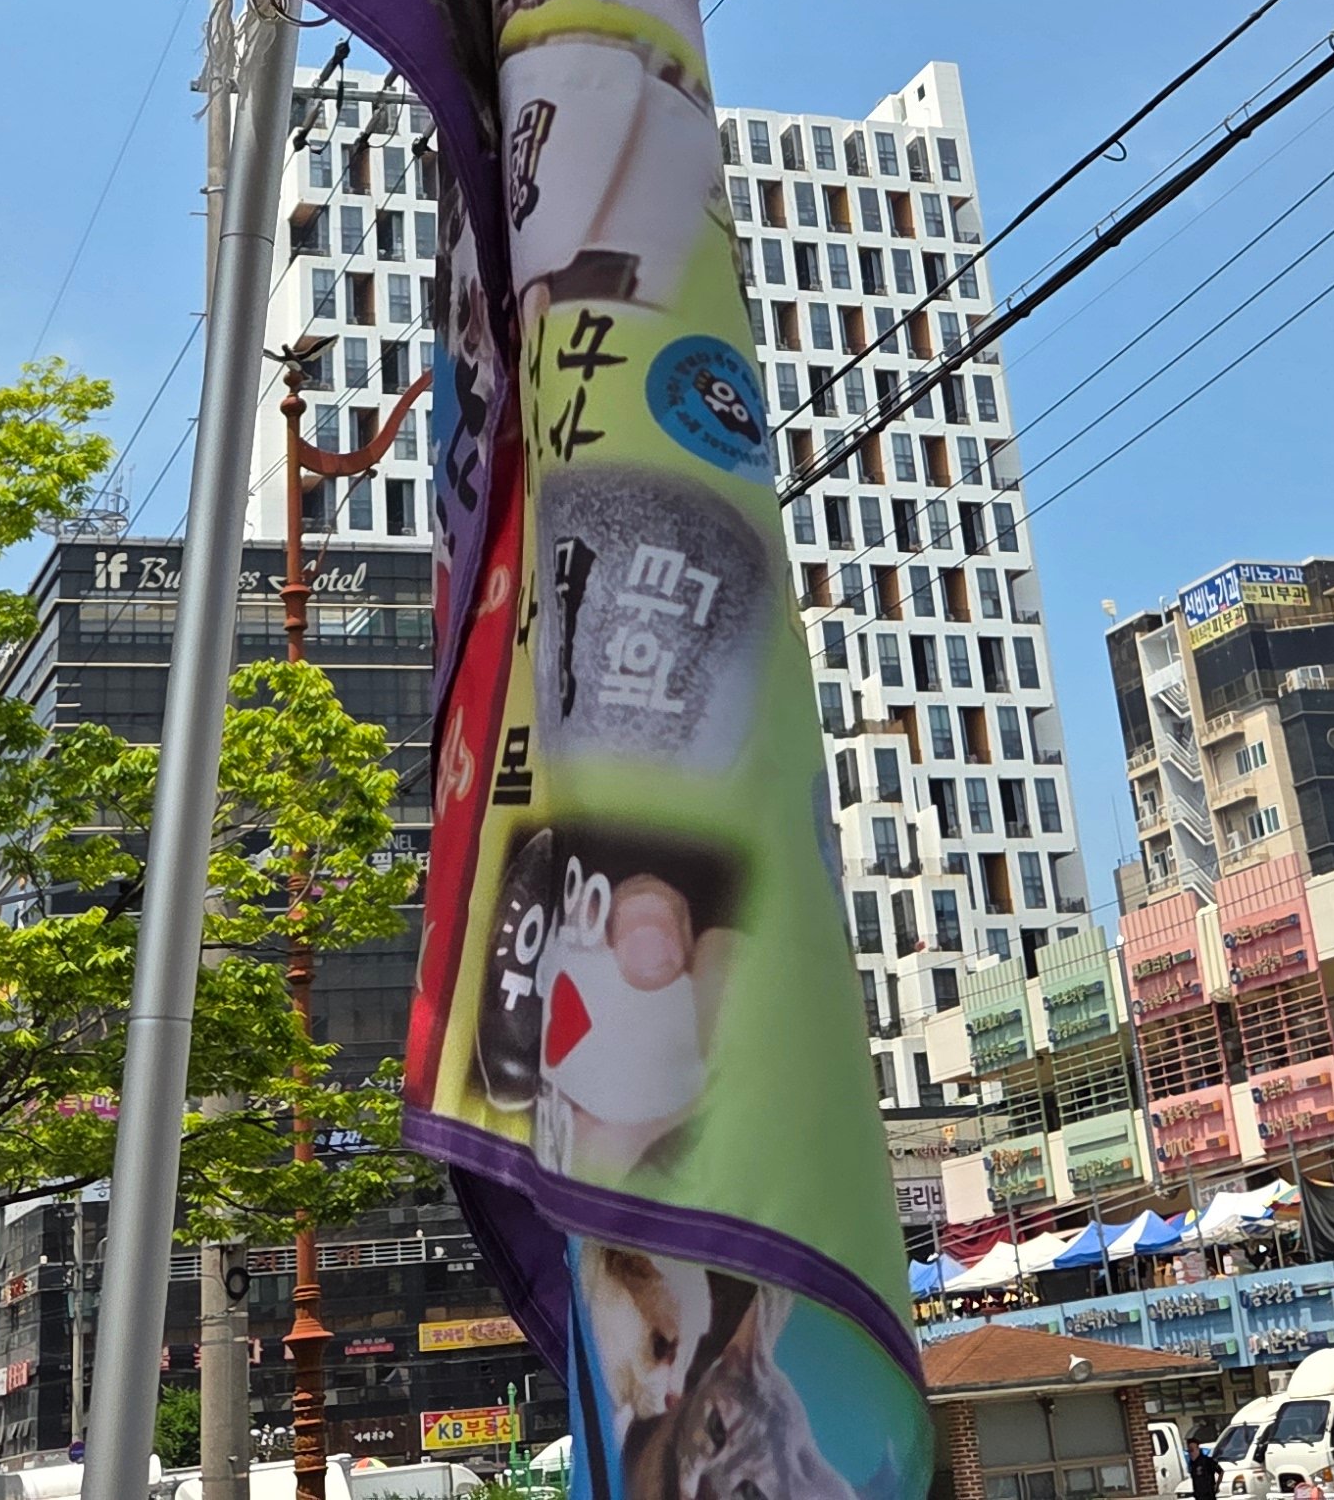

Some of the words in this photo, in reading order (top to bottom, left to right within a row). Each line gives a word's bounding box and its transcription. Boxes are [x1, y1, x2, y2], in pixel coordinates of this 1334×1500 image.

[95, 551, 128, 589] if
[1260, 585, 1307, 602] 피부과
[1212, 605, 1244, 633] 피부과
